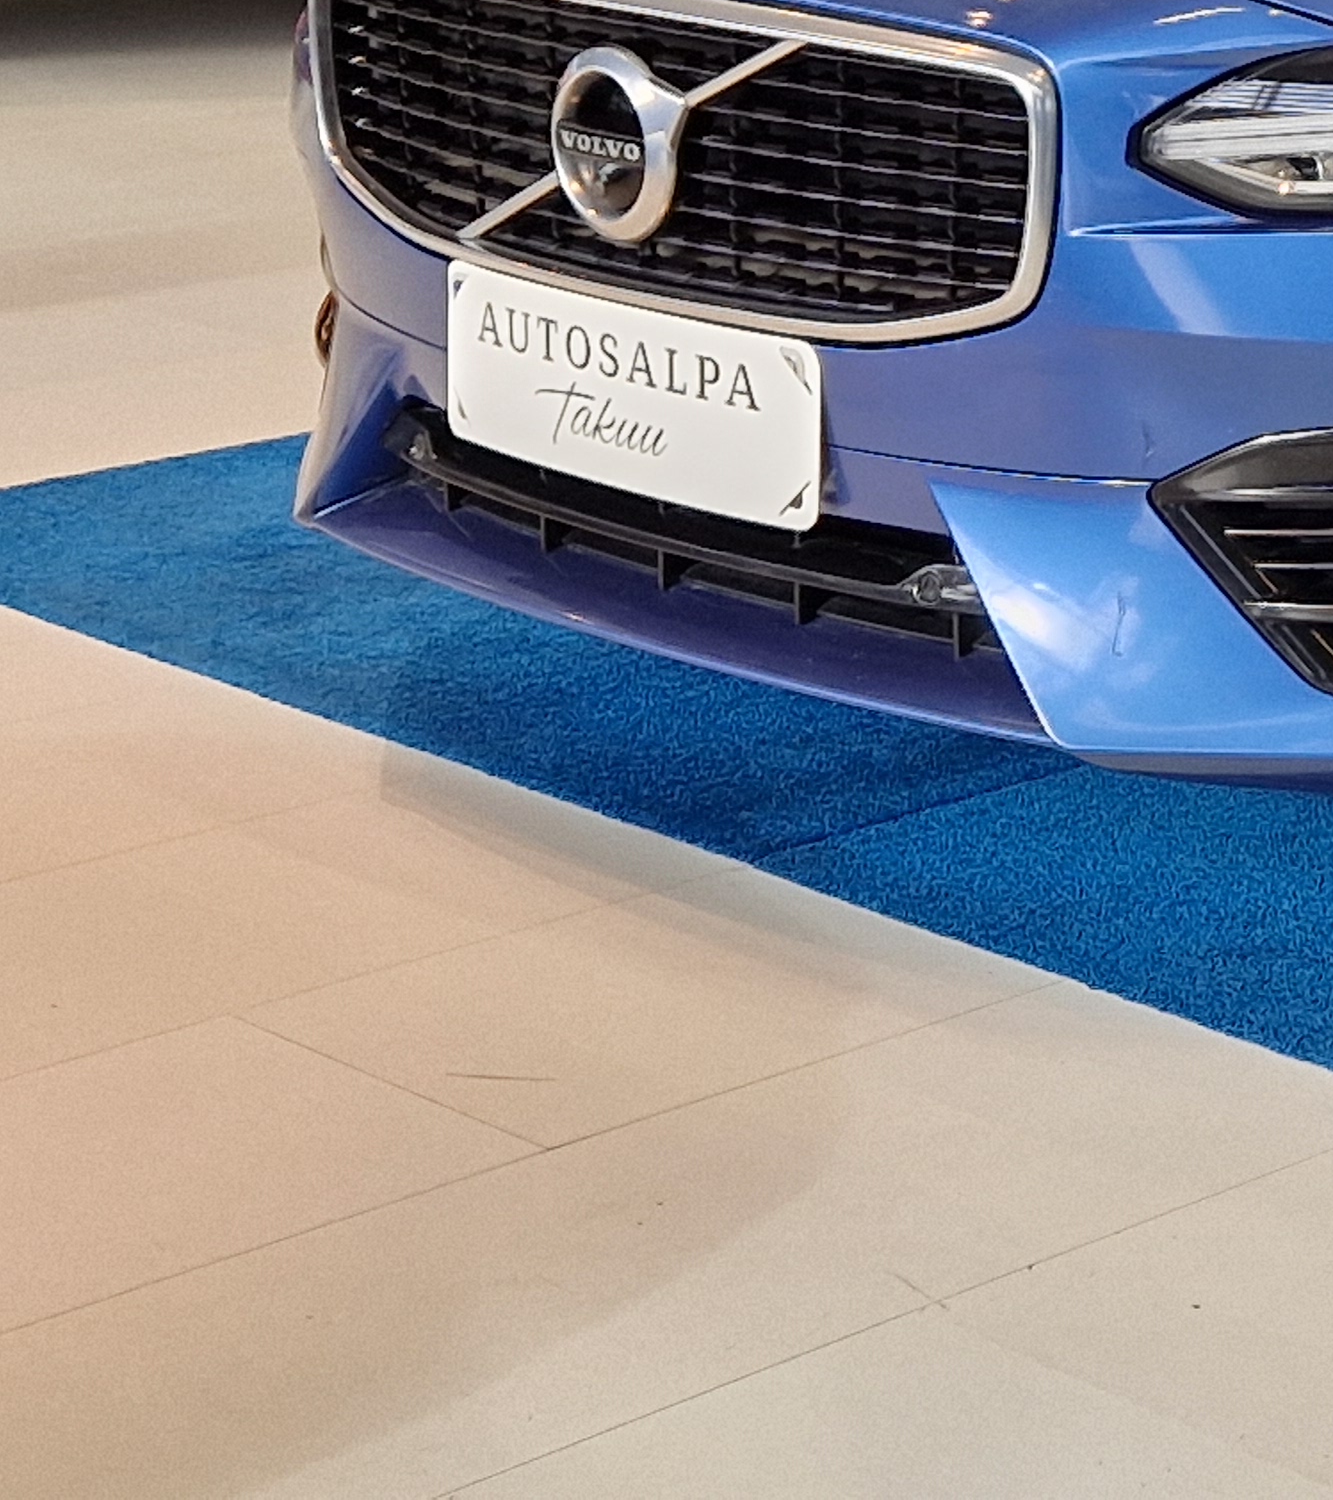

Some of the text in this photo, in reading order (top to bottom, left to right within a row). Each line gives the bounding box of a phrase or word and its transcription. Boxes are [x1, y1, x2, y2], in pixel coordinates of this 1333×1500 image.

[560, 128, 642, 164] VOLVO
[478, 302, 761, 412] AUTOSALPA
[534, 382, 667, 457] Takuu
